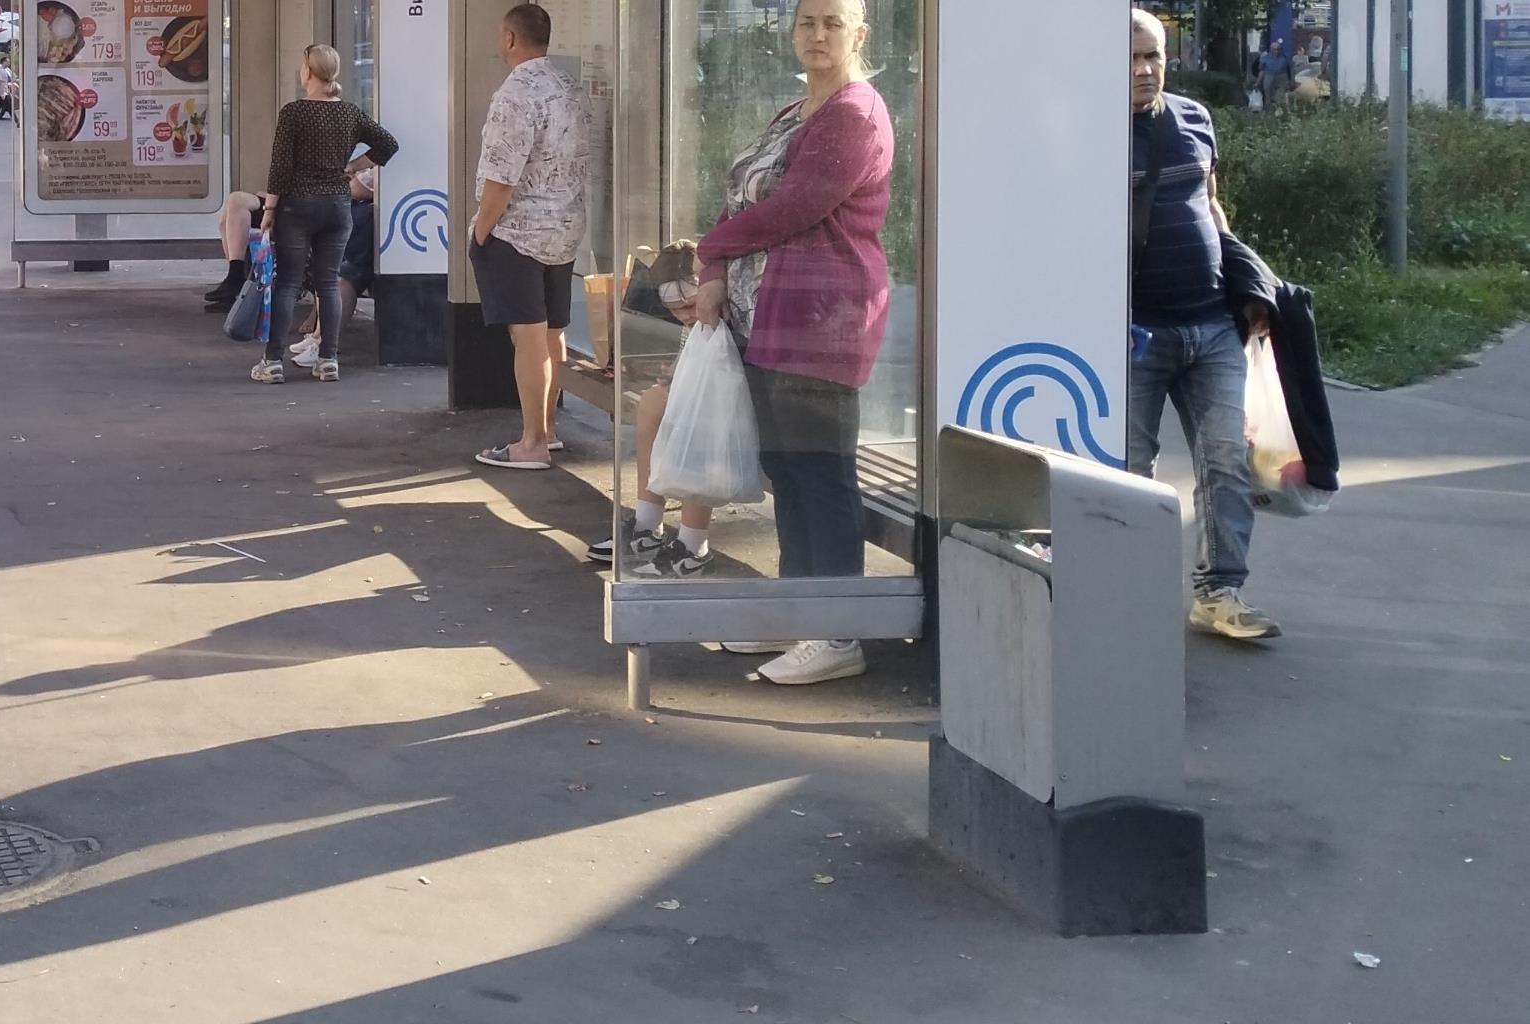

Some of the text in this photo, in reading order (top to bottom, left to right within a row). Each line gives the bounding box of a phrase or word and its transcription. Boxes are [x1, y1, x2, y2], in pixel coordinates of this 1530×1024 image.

[133, 4, 192, 15] И ВЫГОДНО
[92, 42, 114, 59] 179
[136, 70, 155, 86] 119
[93, 121, 110, 137] 59
[136, 145, 156, 162] 119
